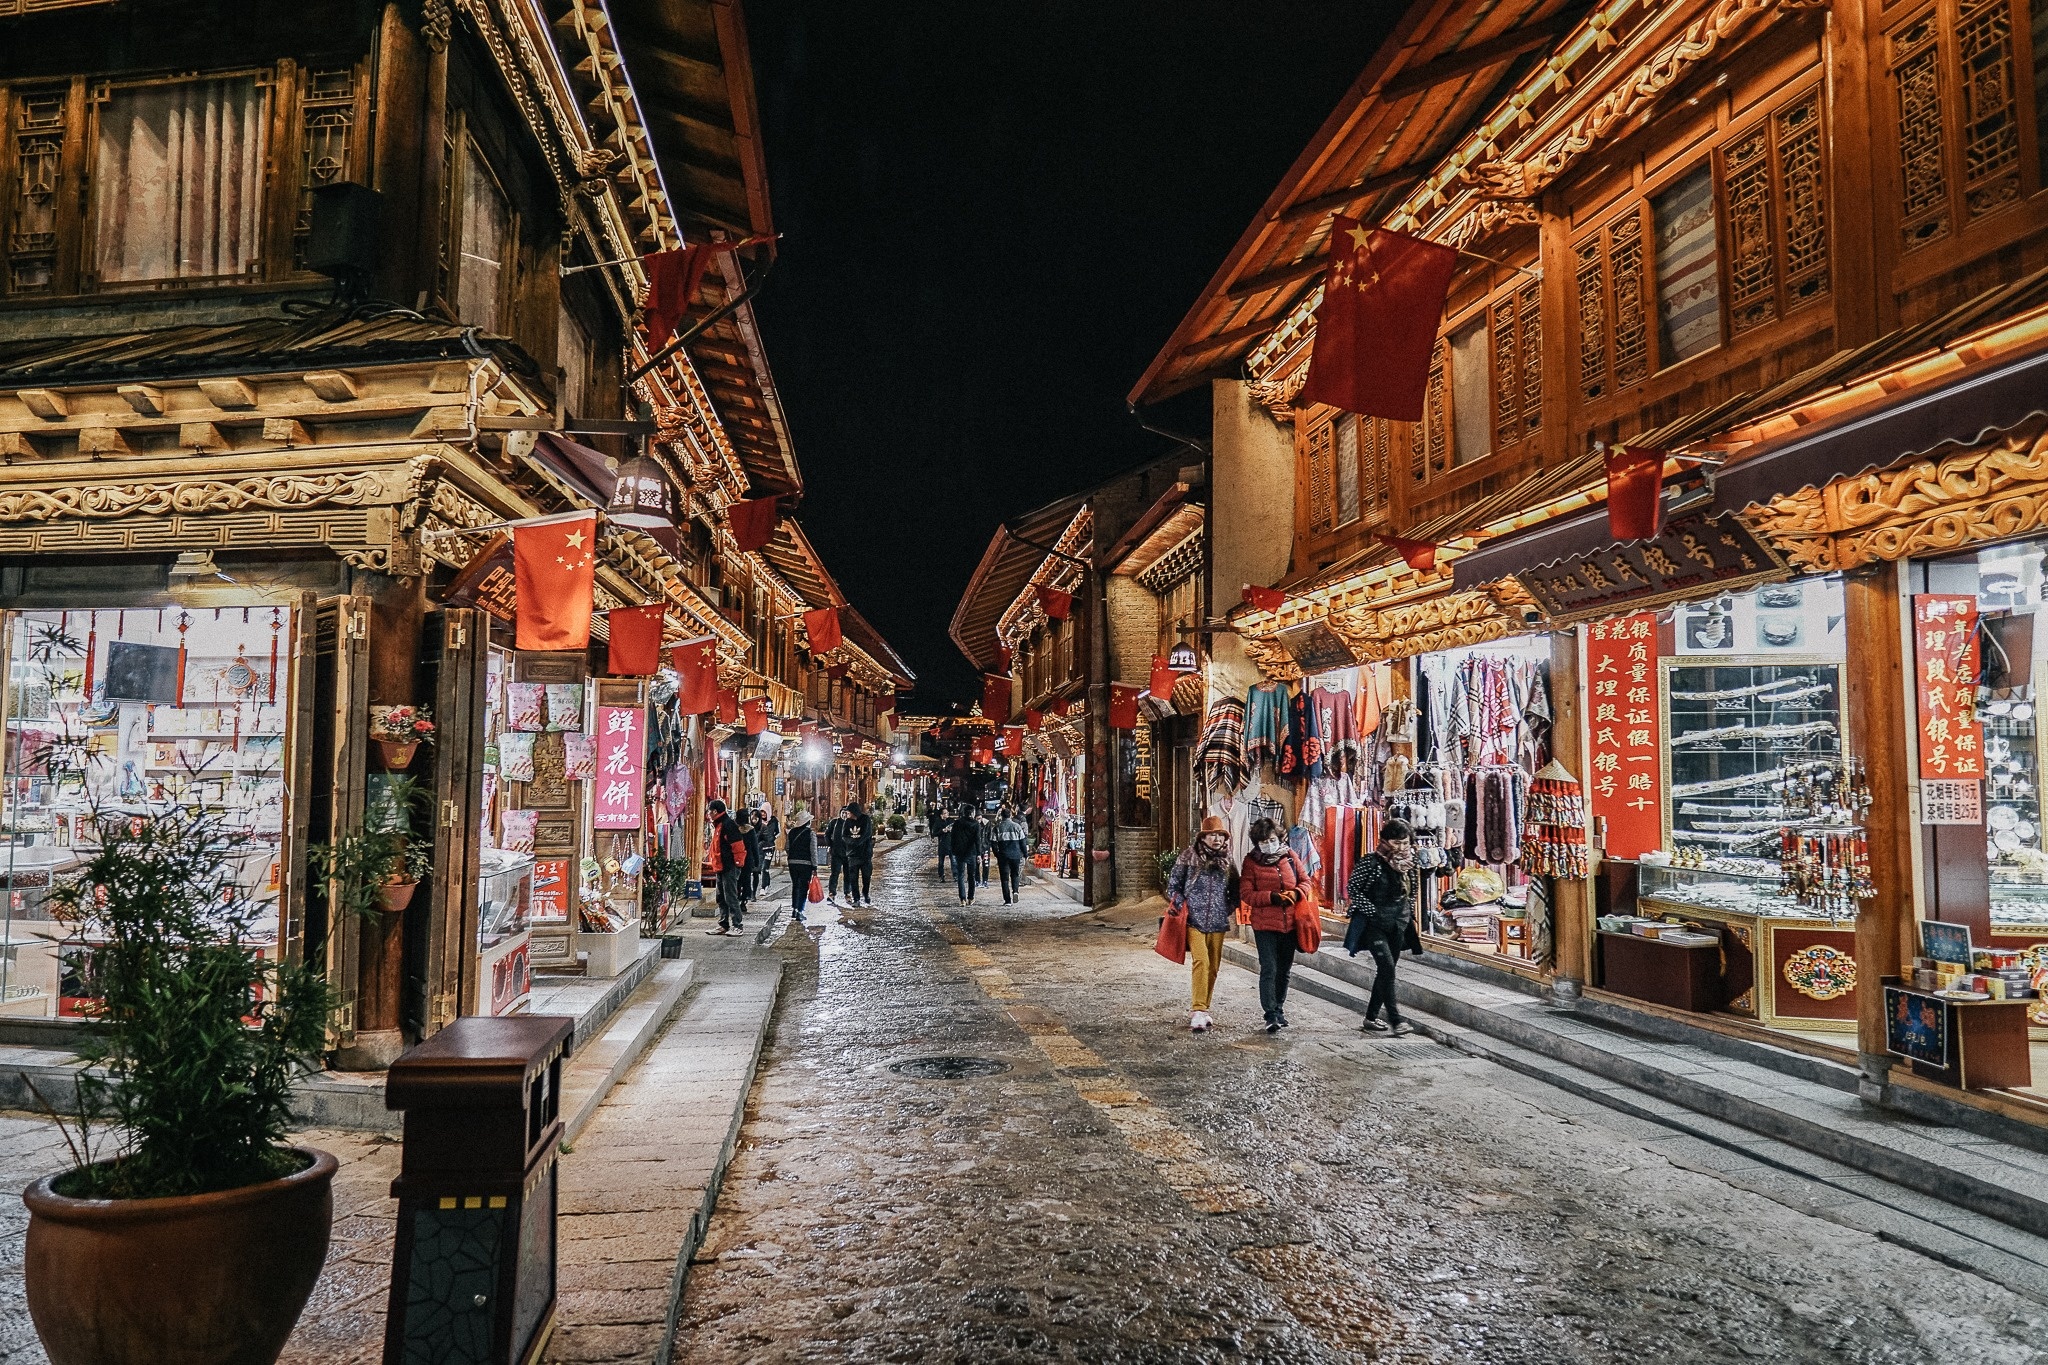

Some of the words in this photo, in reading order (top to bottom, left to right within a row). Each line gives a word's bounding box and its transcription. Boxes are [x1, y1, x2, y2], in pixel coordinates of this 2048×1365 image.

[1580, 533, 1715, 591] 段氏银号
[1593, 654, 1622, 798] 大理段氏银号
[1949, 599, 1980, 774] 百年老店质量保证
[602, 709, 637, 811] 鲜花饼
[596, 813, 640, 823] 云南特产
